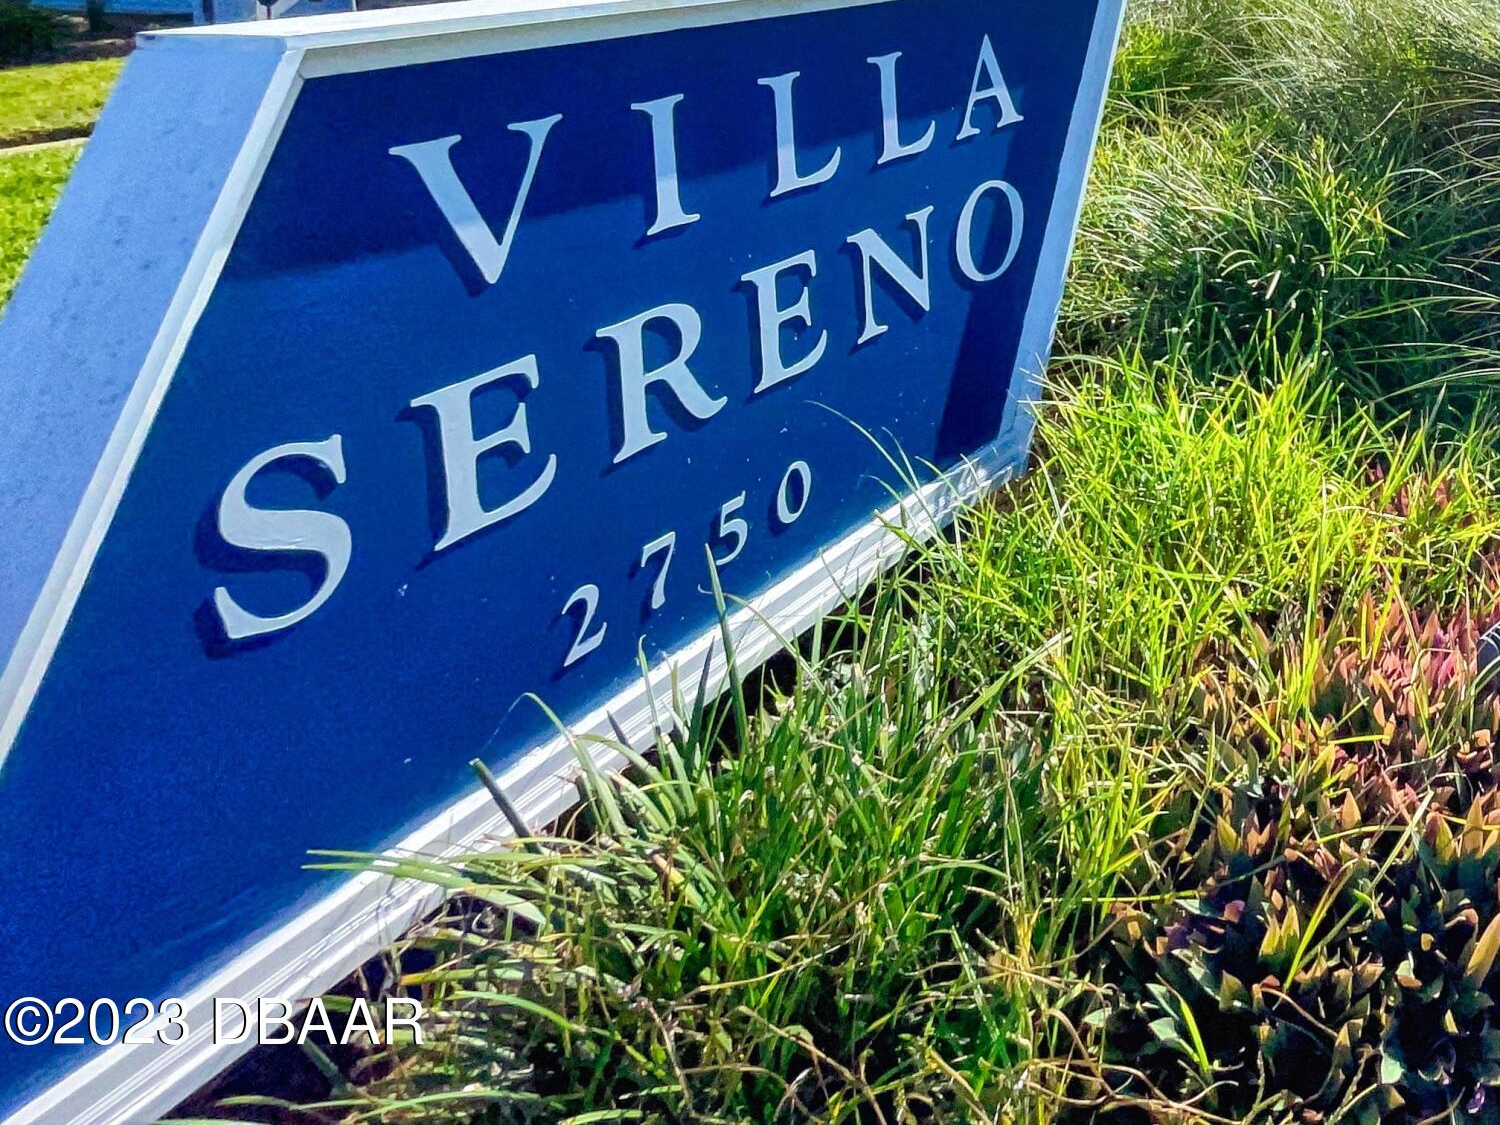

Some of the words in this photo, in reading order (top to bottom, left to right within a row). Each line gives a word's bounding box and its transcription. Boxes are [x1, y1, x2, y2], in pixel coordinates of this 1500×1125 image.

[389, 33, 1024, 284] VILLA
[213, 179, 1025, 640] SERENO
[561, 460, 812, 667] 2750
